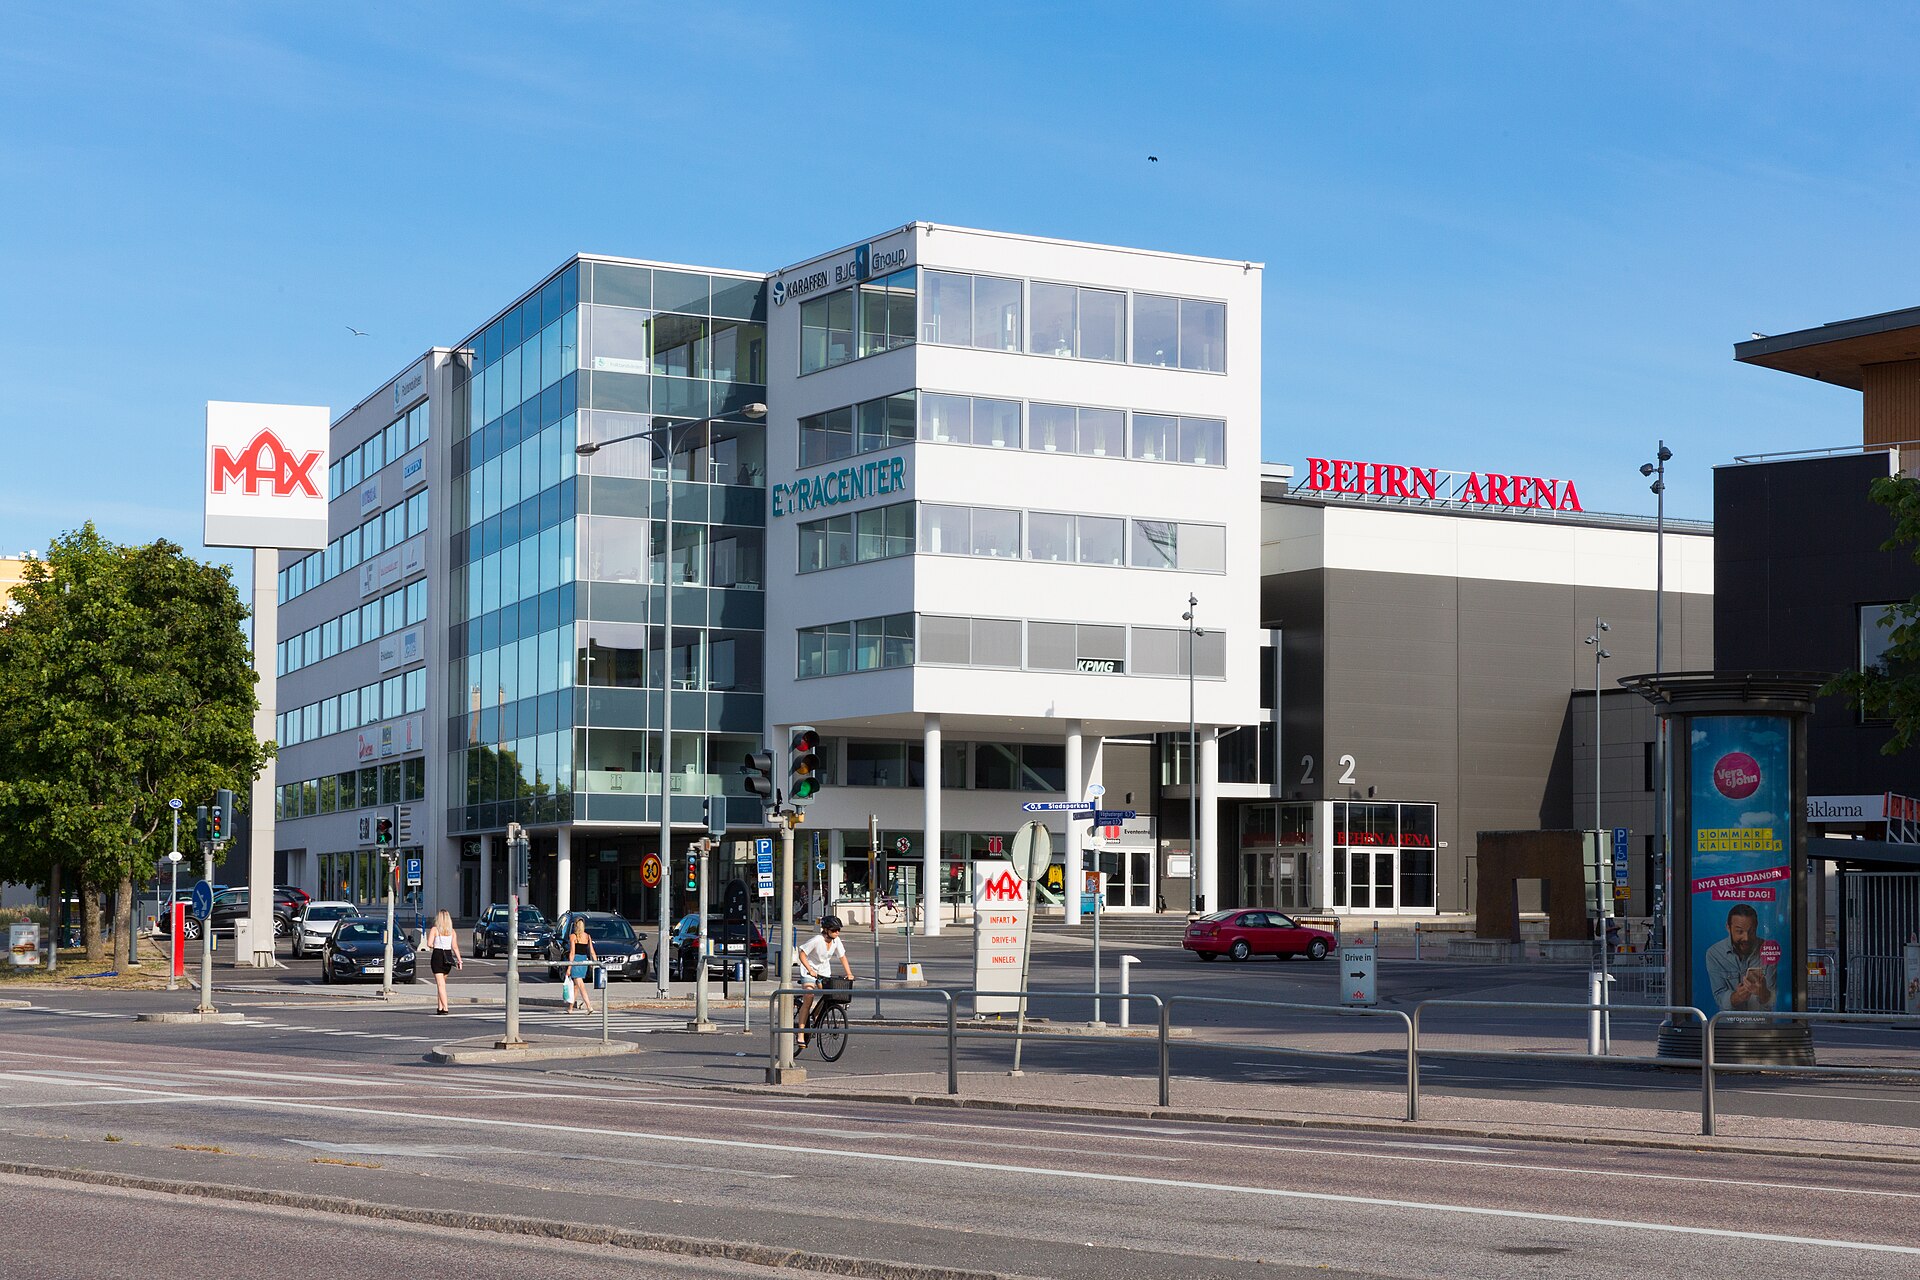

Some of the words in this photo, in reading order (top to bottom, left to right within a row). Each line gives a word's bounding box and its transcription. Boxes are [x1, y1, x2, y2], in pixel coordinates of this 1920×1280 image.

[872, 248, 907, 271] Group
[787, 270, 829, 298] KARAFFEN
[211, 427, 324, 499] MAX
[772, 456, 907, 518] EYRACENTER
[1306, 457, 1439, 500] BEHRN
[1460, 471, 1584, 513] ARENA
[1077, 660, 1115, 673] KPMG
[1300, 754, 1314, 784] 2
[1338, 754, 1356, 784] 2
[1717, 768, 1743, 780] Vera
[1048, 803, 1089, 811] Stadsparken
[1337, 831, 1384, 845] BEHRN
[1387, 832, 1431, 846] ARENA
[1617, 829, 1626, 843] P
[761, 841, 770, 854] P
[1700, 841, 1780, 850] KALENDER
[410, 860, 419, 871] P
[644, 861, 659, 880] 30
[985, 869, 1023, 901] MAX
[1698, 880, 1717, 890] NYA
[1718, 870, 1782, 887] ERBJUDANDEN
[1718, 890, 1746, 898] VARJE
[1748, 890, 1771, 899] DAG!
[990, 916, 1011, 925] INFART
[991, 936, 1017, 944] DRIVE-IN
[991, 956, 1016, 964] INNELEK
[1345, 953, 1364, 962] Drive
[1364, 953, 1372, 962] in
